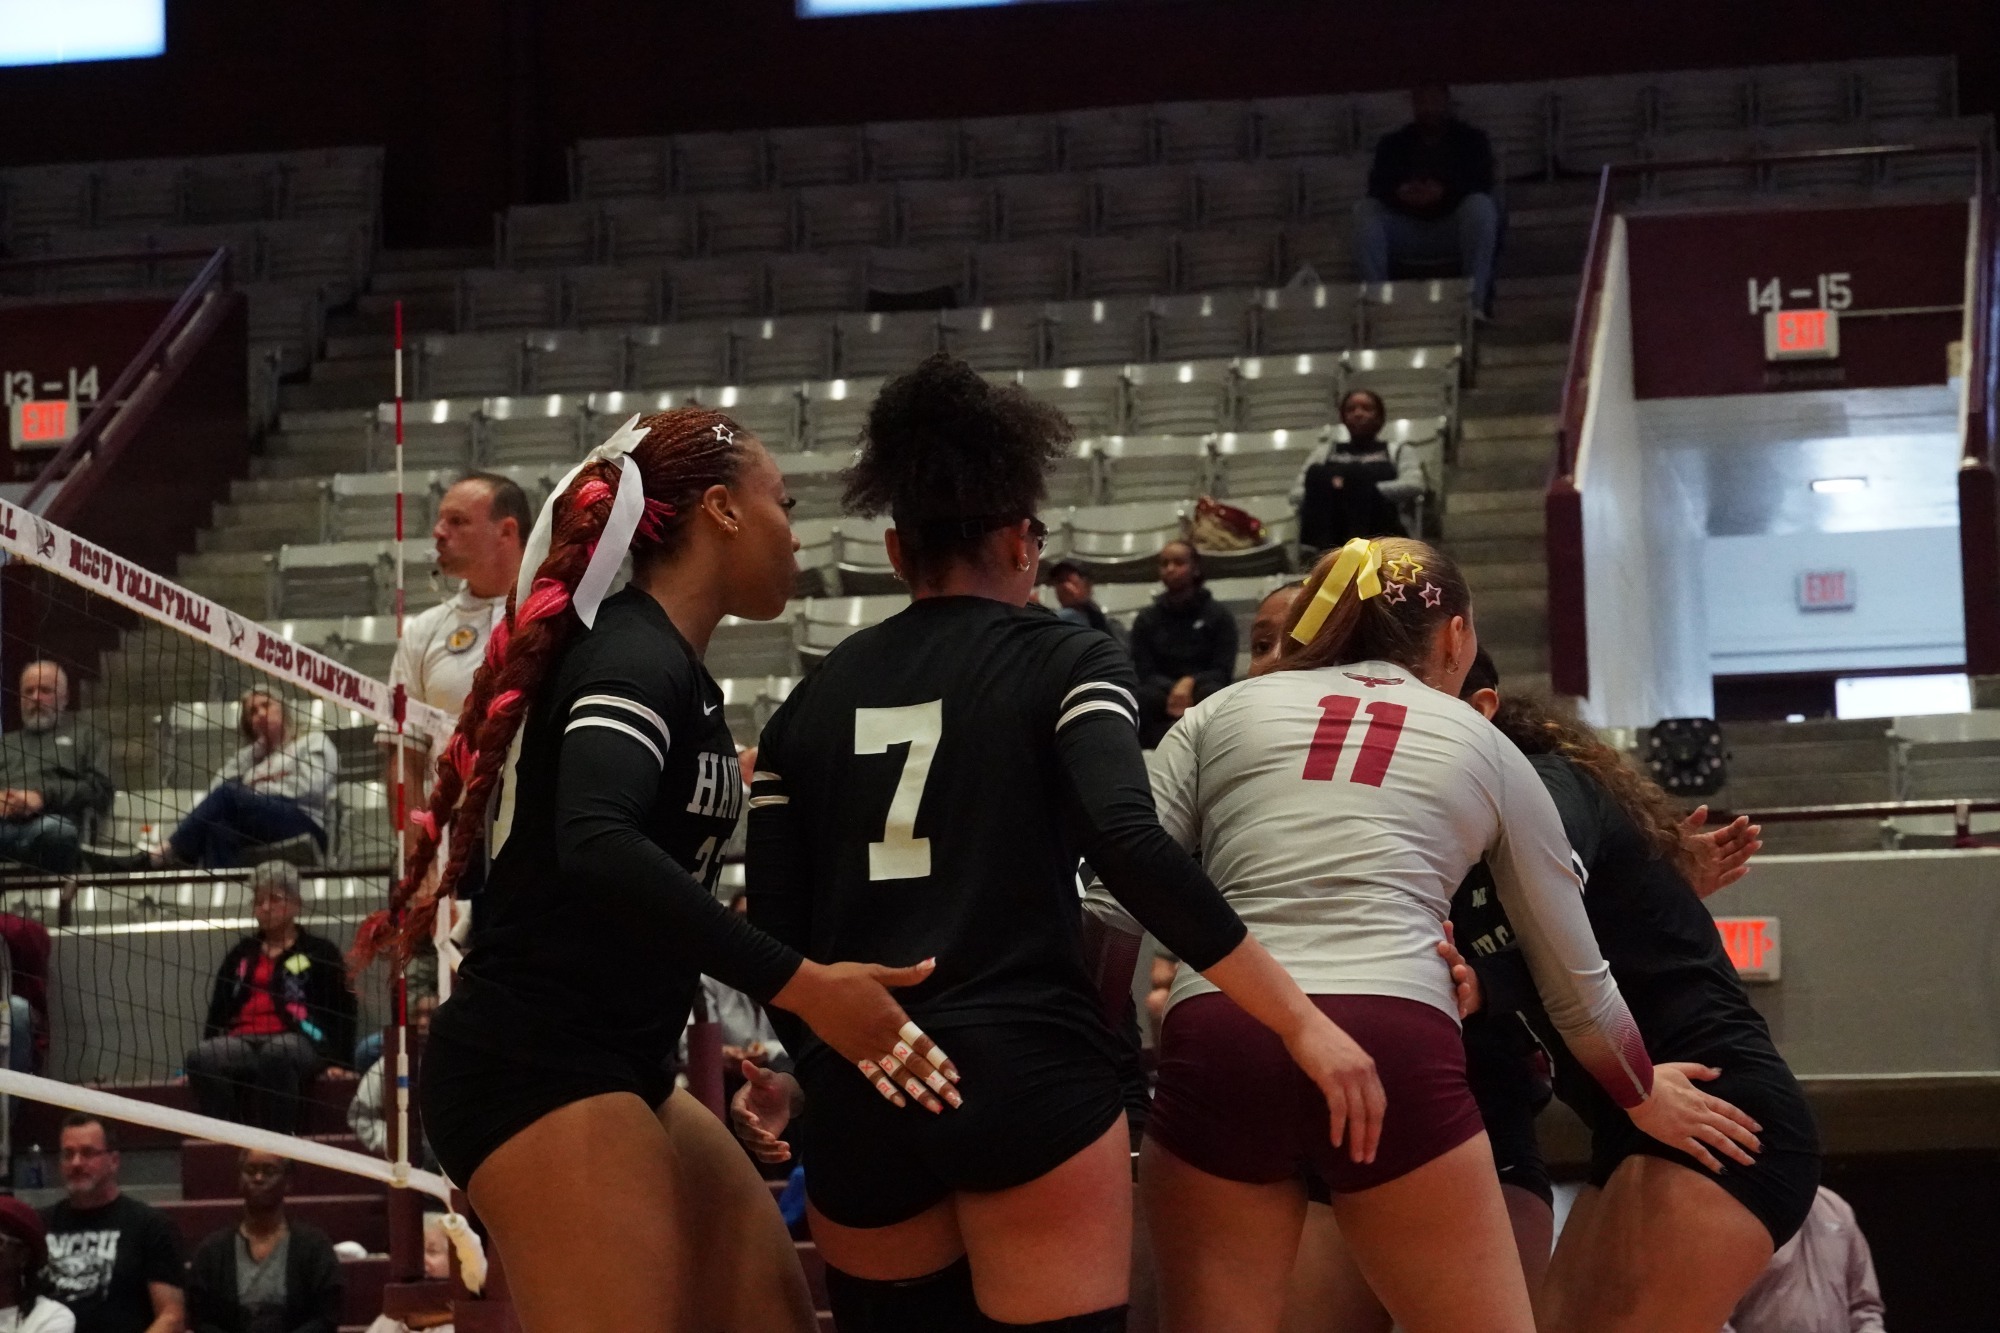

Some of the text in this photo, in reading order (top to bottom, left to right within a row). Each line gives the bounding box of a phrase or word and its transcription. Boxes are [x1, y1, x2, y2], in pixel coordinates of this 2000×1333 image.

[1777, 310, 1829, 351] EXIT
[22, 401, 67, 441] EXIT
[1804, 572, 1846, 604] EXIT
[1302, 694, 1407, 788] 11
[854, 699, 942, 880] 7
[1712, 921, 1766, 968] XIT
